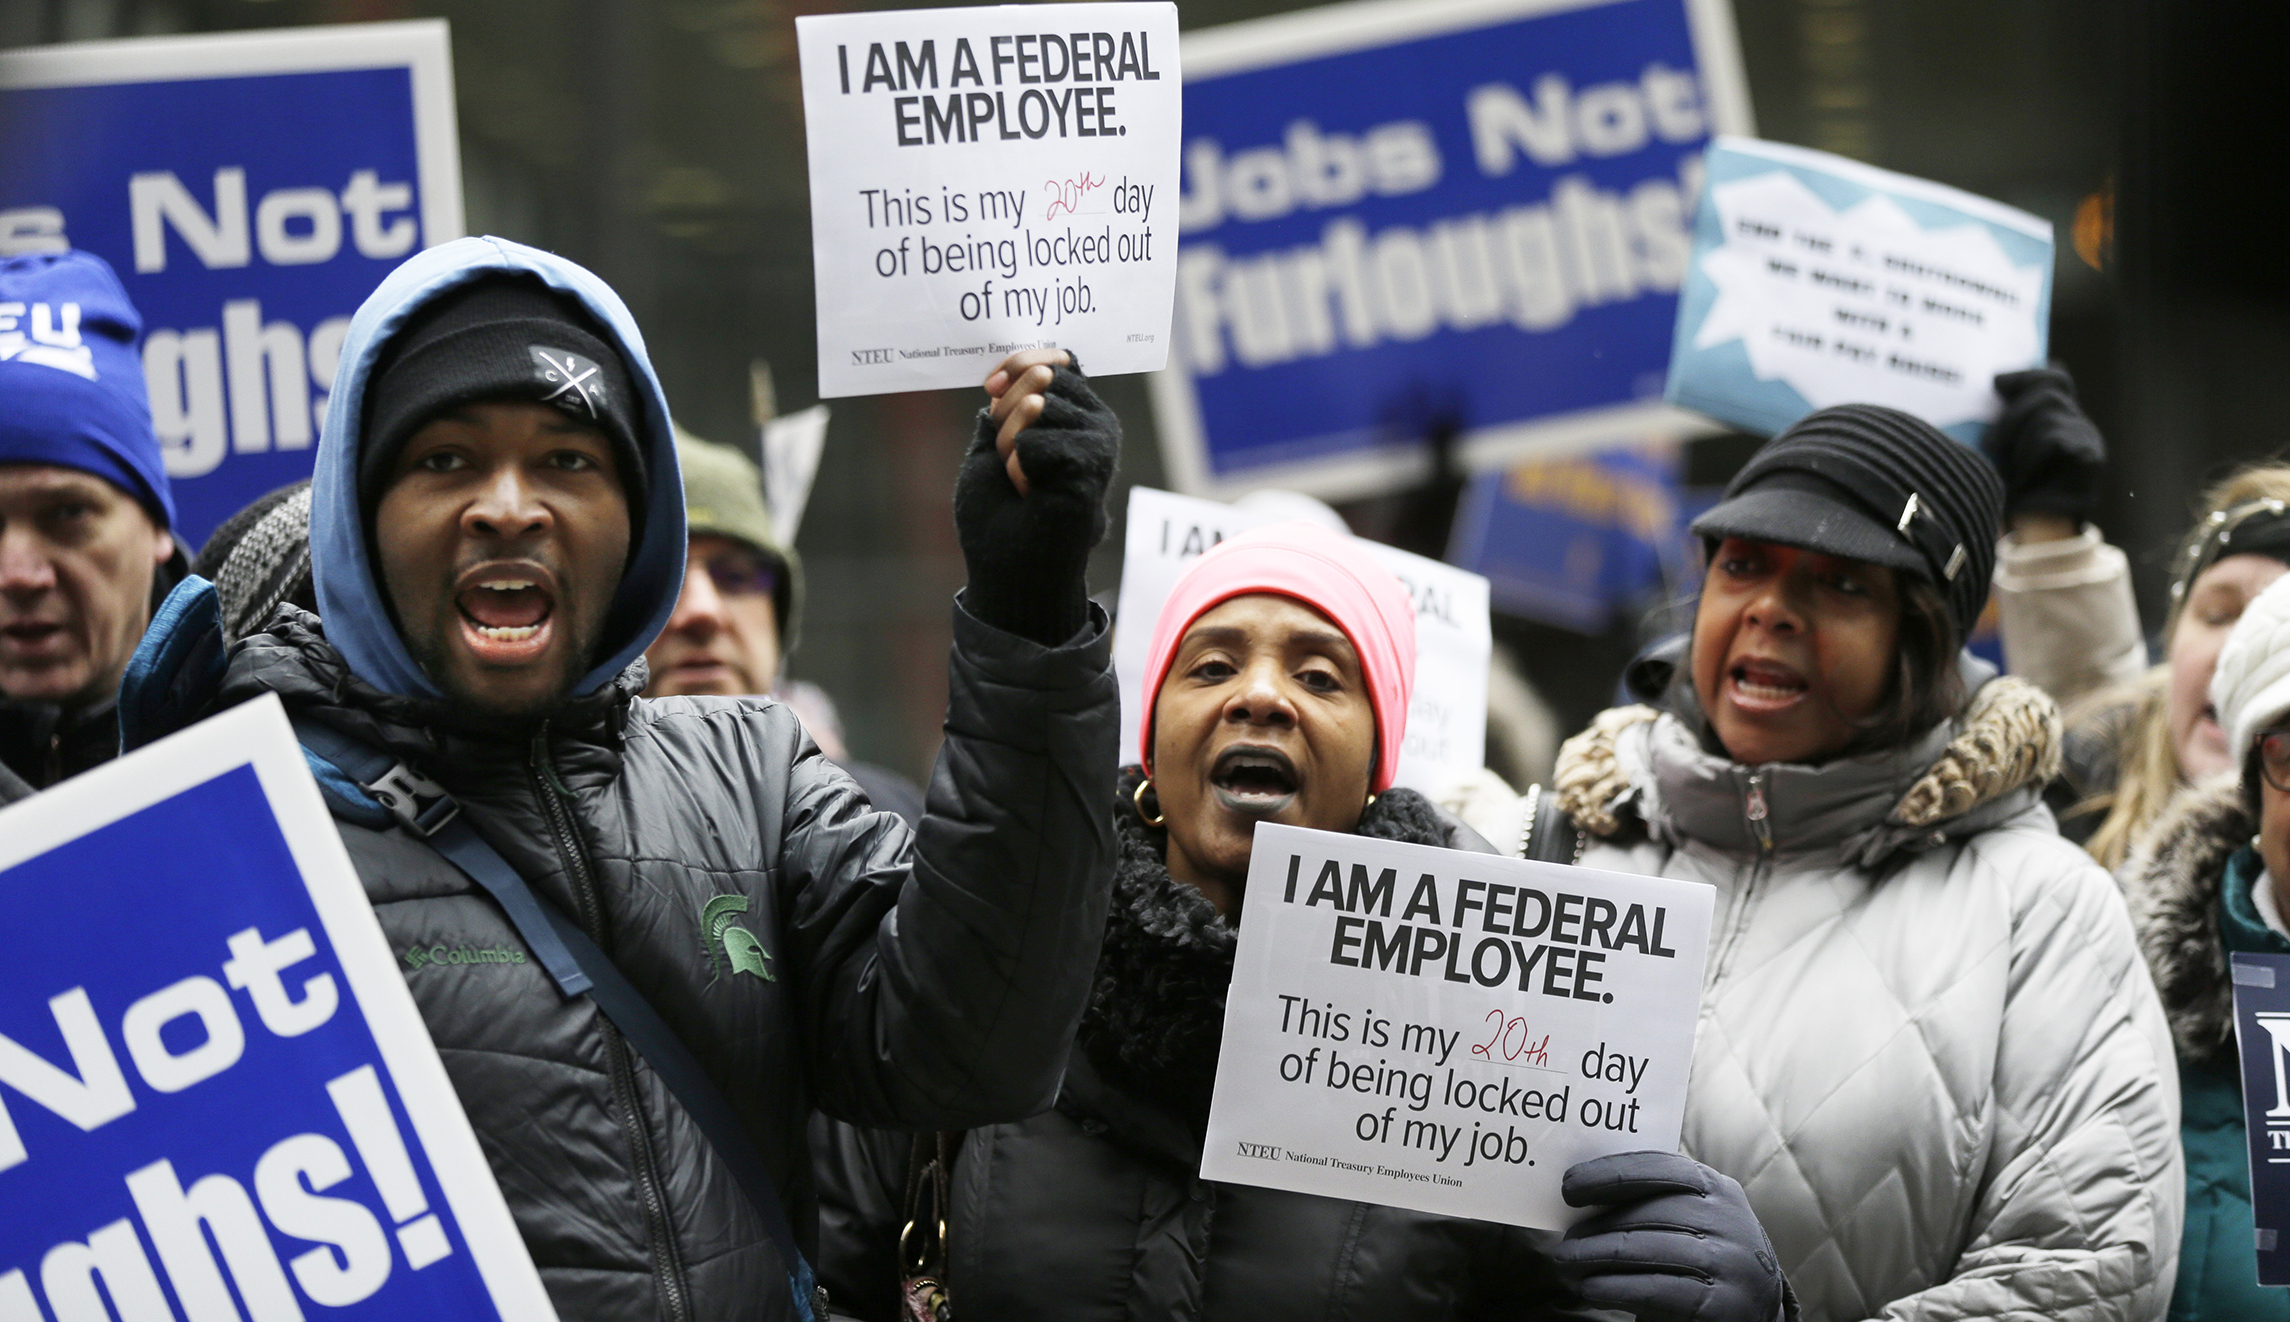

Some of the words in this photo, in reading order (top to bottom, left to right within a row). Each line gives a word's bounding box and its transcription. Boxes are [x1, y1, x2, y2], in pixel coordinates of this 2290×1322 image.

[837, 45, 850, 94] I
[863, 40, 938, 92] AM
[950, 38, 984, 87] A
[990, 31, 1160, 85] FEDERAL
[894, 87, 1126, 146] EMPLOYEE.
[1179, 119, 1442, 232] Jobs
[1468, 61, 1705, 176] Not
[129, 166, 417, 273] Not
[860, 187, 932, 228] This
[942, 186, 968, 222] is
[980, 190, 1025, 228] my
[1044, 171, 1106, 221] 20th
[1113, 176, 1154, 223] day
[876, 237, 910, 277] of
[921, 234, 1016, 278] being
[1026, 225, 1110, 267] locked
[1117, 226, 1152, 263] out
[960, 281, 993, 321] of
[1005, 288, 1047, 326] my
[1055, 275, 1097, 324] job.
[852, 348, 894, 365] NTEU
[898, 347, 941, 360] National
[943, 343, 986, 358] Treasury
[988, 341, 1036, 355] Employees
[1126, 333, 1154, 344] NTEU.org
[1283, 855, 1301, 903] I
[1305, 860, 1397, 917] AM
[1401, 873, 1442, 925] A
[1452, 879, 1676, 958] FEDERAL
[429, 943, 526, 965] Columbia
[1329, 918, 1614, 1005] EMPLOYEE.
[0, 926, 340, 1172] Not
[1278, 995, 1350, 1042] This
[1361, 1009, 1390, 1048] is
[1402, 1022, 1460, 1067] my
[1471, 1009, 1548, 1067] 20th
[1581, 1042, 1649, 1094] day
[1280, 1047, 1321, 1083] of
[1326, 1051, 1433, 1112] being
[1443, 1068, 1570, 1123] locked
[1580, 1098, 1640, 1134] out
[1237, 1141, 1282, 1161] NTEU
[1285, 1151, 1328, 1167] National
[1329, 1158, 1375, 1175] Treasury
[1376, 1165, 1430, 1183] Employees
[1432, 1173, 1464, 1188] Union
[1355, 1107, 1397, 1144] of
[1403, 1120, 1461, 1167] my
[1464, 1121, 1536, 1167] job.
